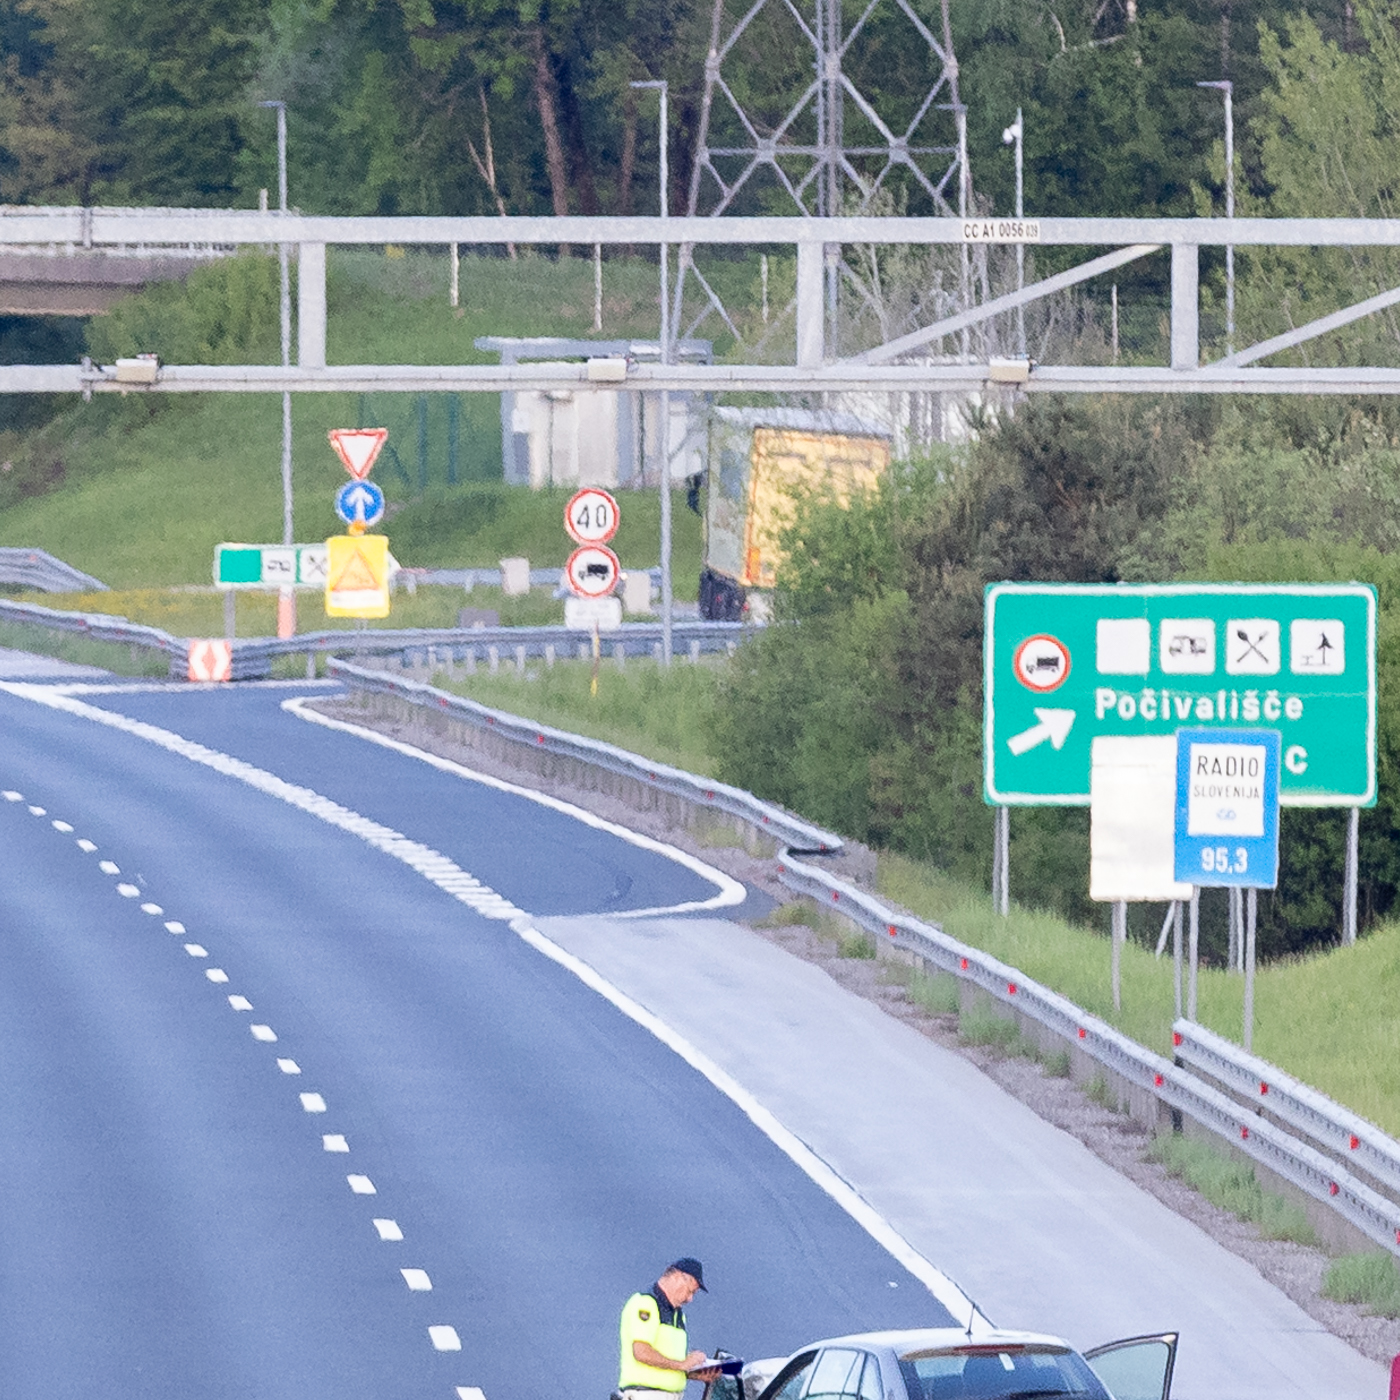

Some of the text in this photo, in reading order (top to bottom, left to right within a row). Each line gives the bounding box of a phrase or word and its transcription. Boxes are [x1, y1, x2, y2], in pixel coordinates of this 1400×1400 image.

[576, 503, 607, 529] 40
[1094, 686, 1305, 721] Počivališče
[1196, 754, 1260, 778] RADIO
[1192, 784, 1261, 799] SLOVENIJA
